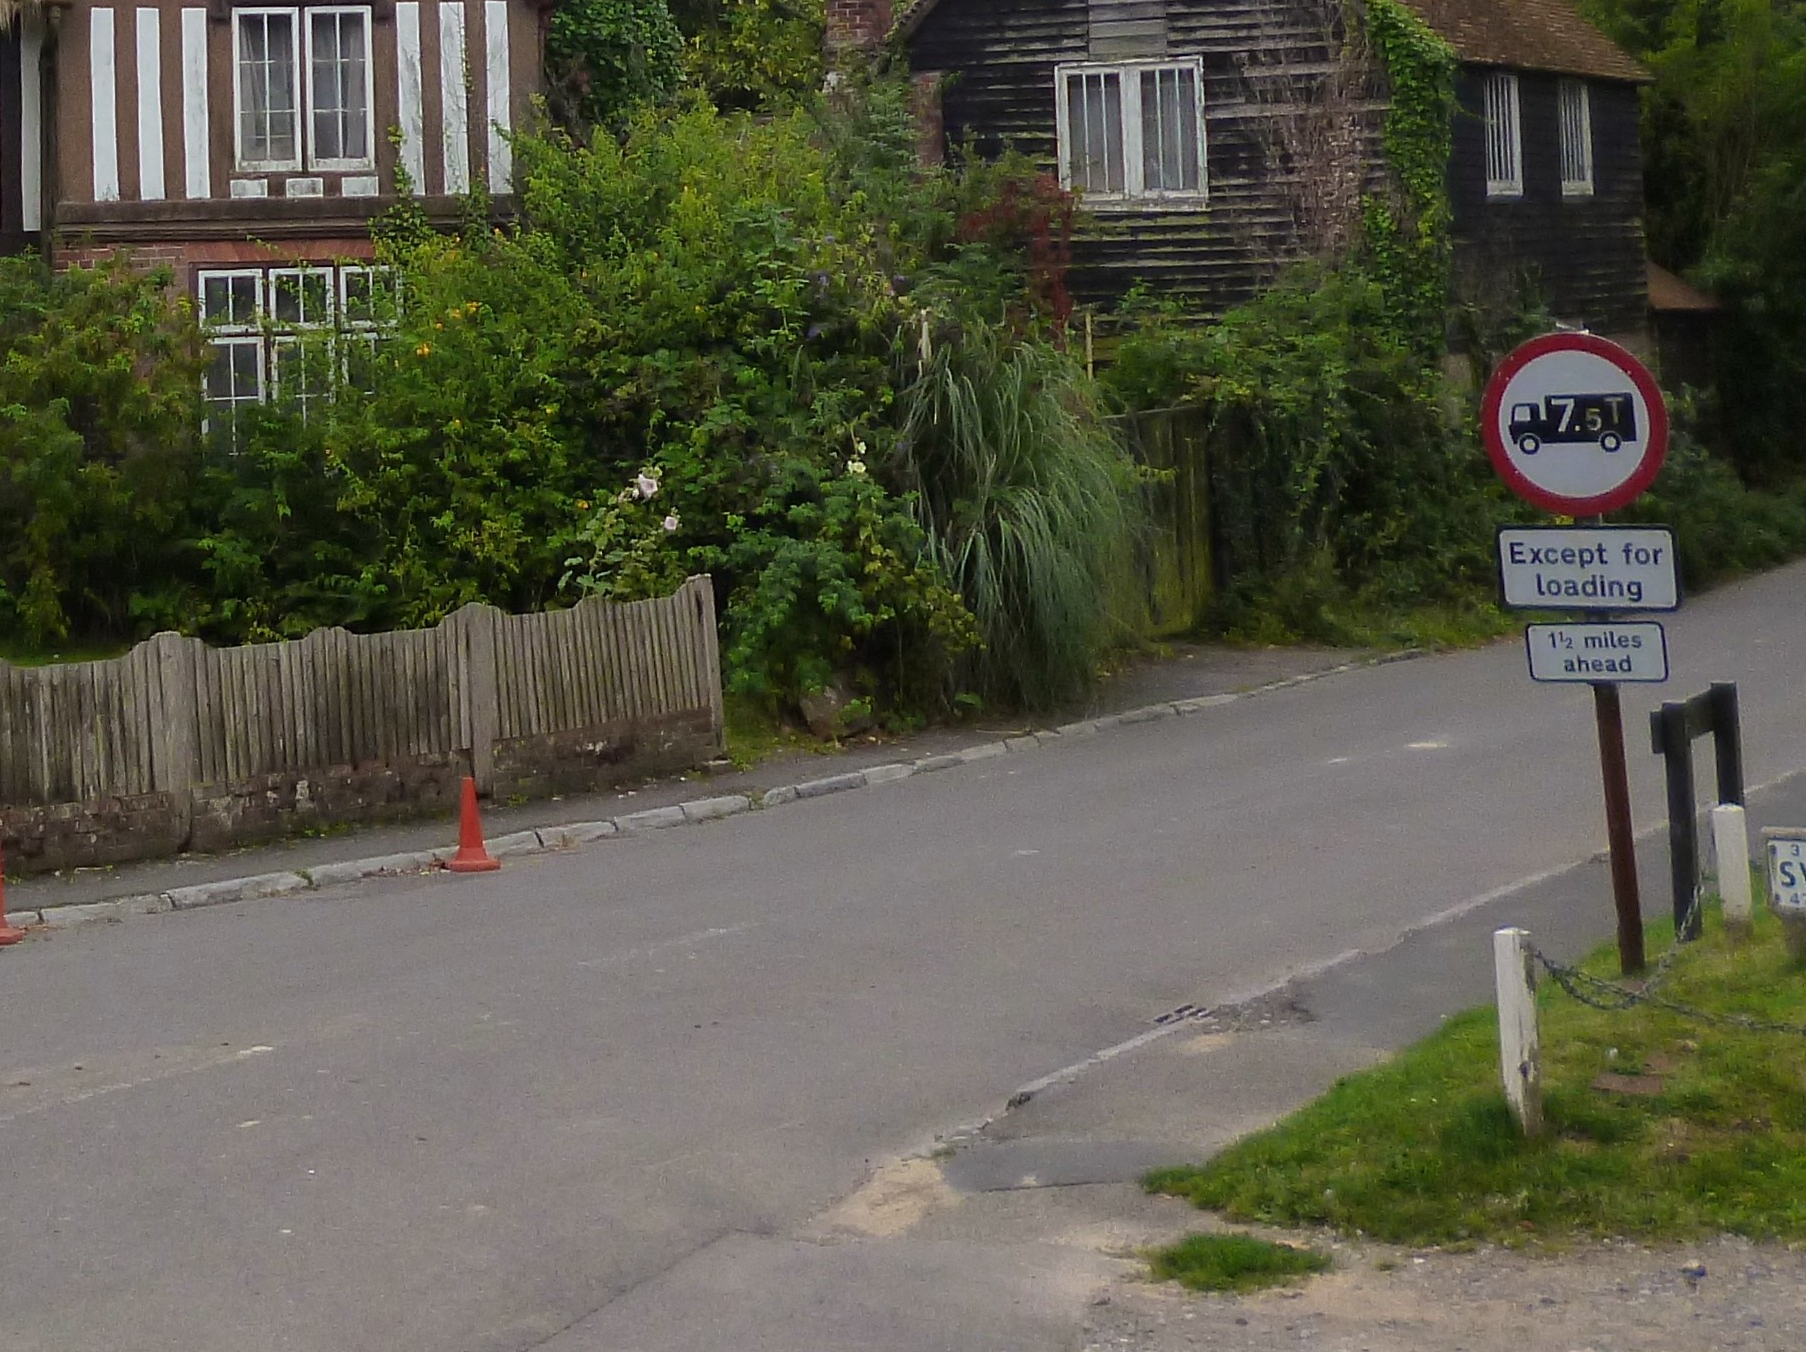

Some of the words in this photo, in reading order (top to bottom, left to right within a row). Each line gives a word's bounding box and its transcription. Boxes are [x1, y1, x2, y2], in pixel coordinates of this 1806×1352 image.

[1509, 542, 1608, 569] Except
[1622, 542, 1663, 565] for
[1536, 573, 1643, 602] loading
[1584, 631, 1642, 649] miles
[1564, 654, 1632, 672] ahead
